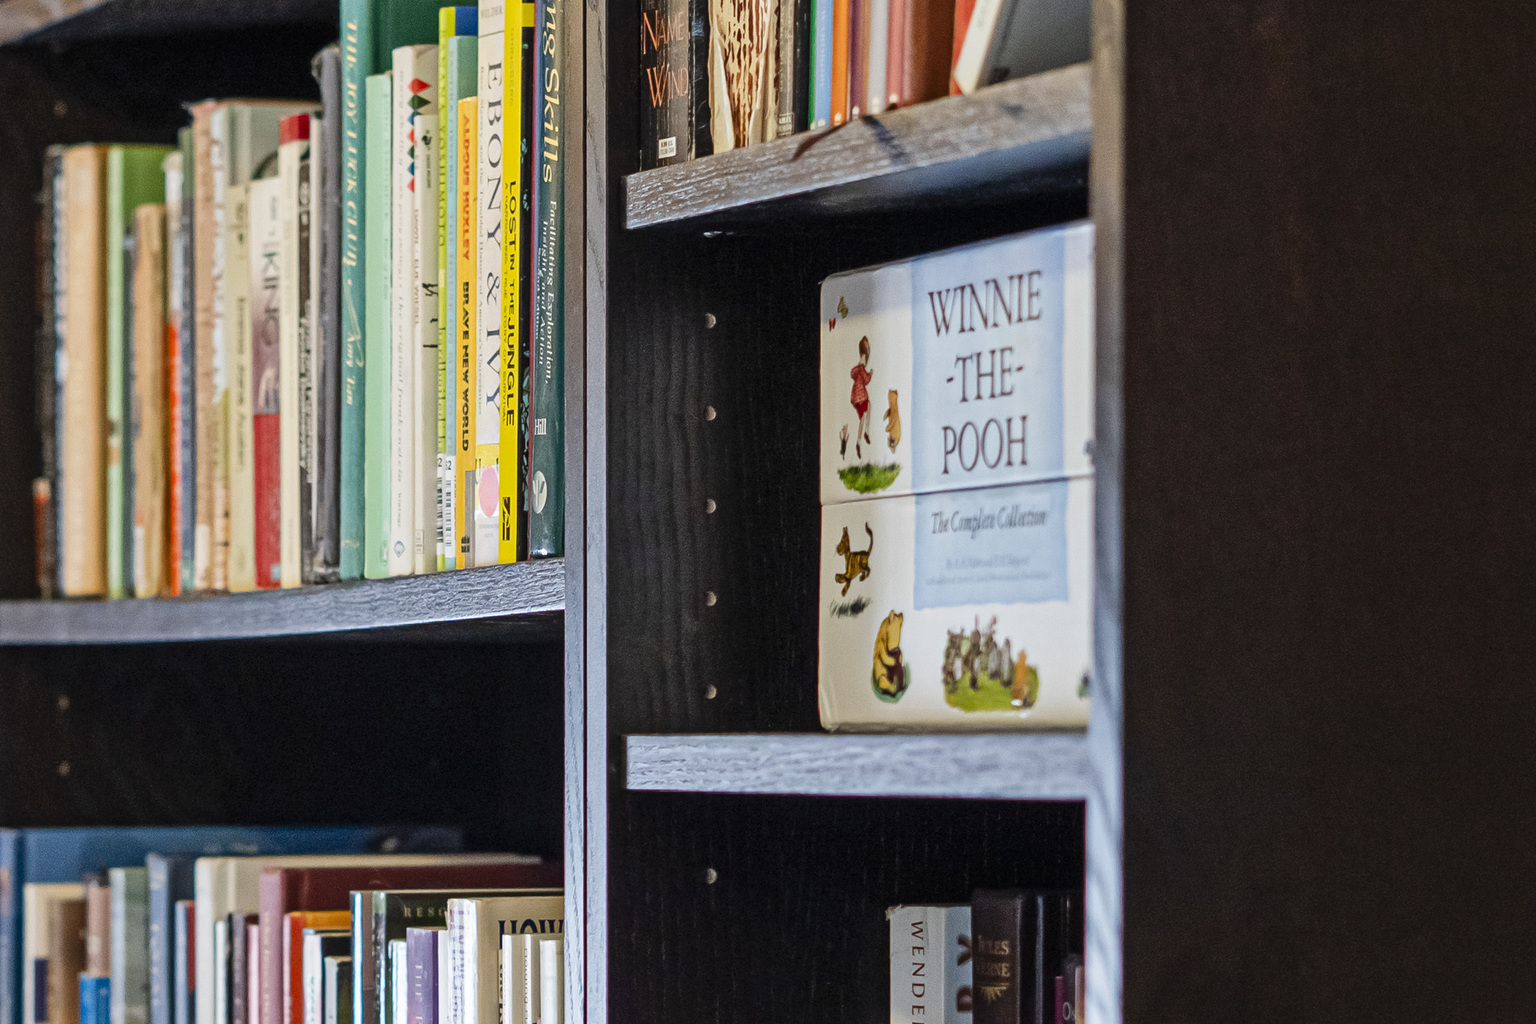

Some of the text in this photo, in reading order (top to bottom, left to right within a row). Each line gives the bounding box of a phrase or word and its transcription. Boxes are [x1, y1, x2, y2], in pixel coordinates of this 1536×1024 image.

[642, 10, 685, 55] NAME
[345, 79, 359, 124] JOY
[646, 64, 689, 108] WIND
[542, 67, 560, 182] Skills
[486, 61, 504, 411] EBONY & IVY
[508, 181, 517, 251] LOST
[509, 253, 516, 271] IN
[545, 199, 557, 385] Facilitating Exploration,
[927, 270, 1042, 338] WINNIE
[462, 281, 470, 452] BRAVE NEW WORLD
[538, 315, 546, 365] Action
[506, 316, 515, 427] JUNGLE
[946, 347, 1024, 403] -THE-
[941, 414, 1029, 476] POOH
[931, 503, 1048, 540] The Complete Collection
